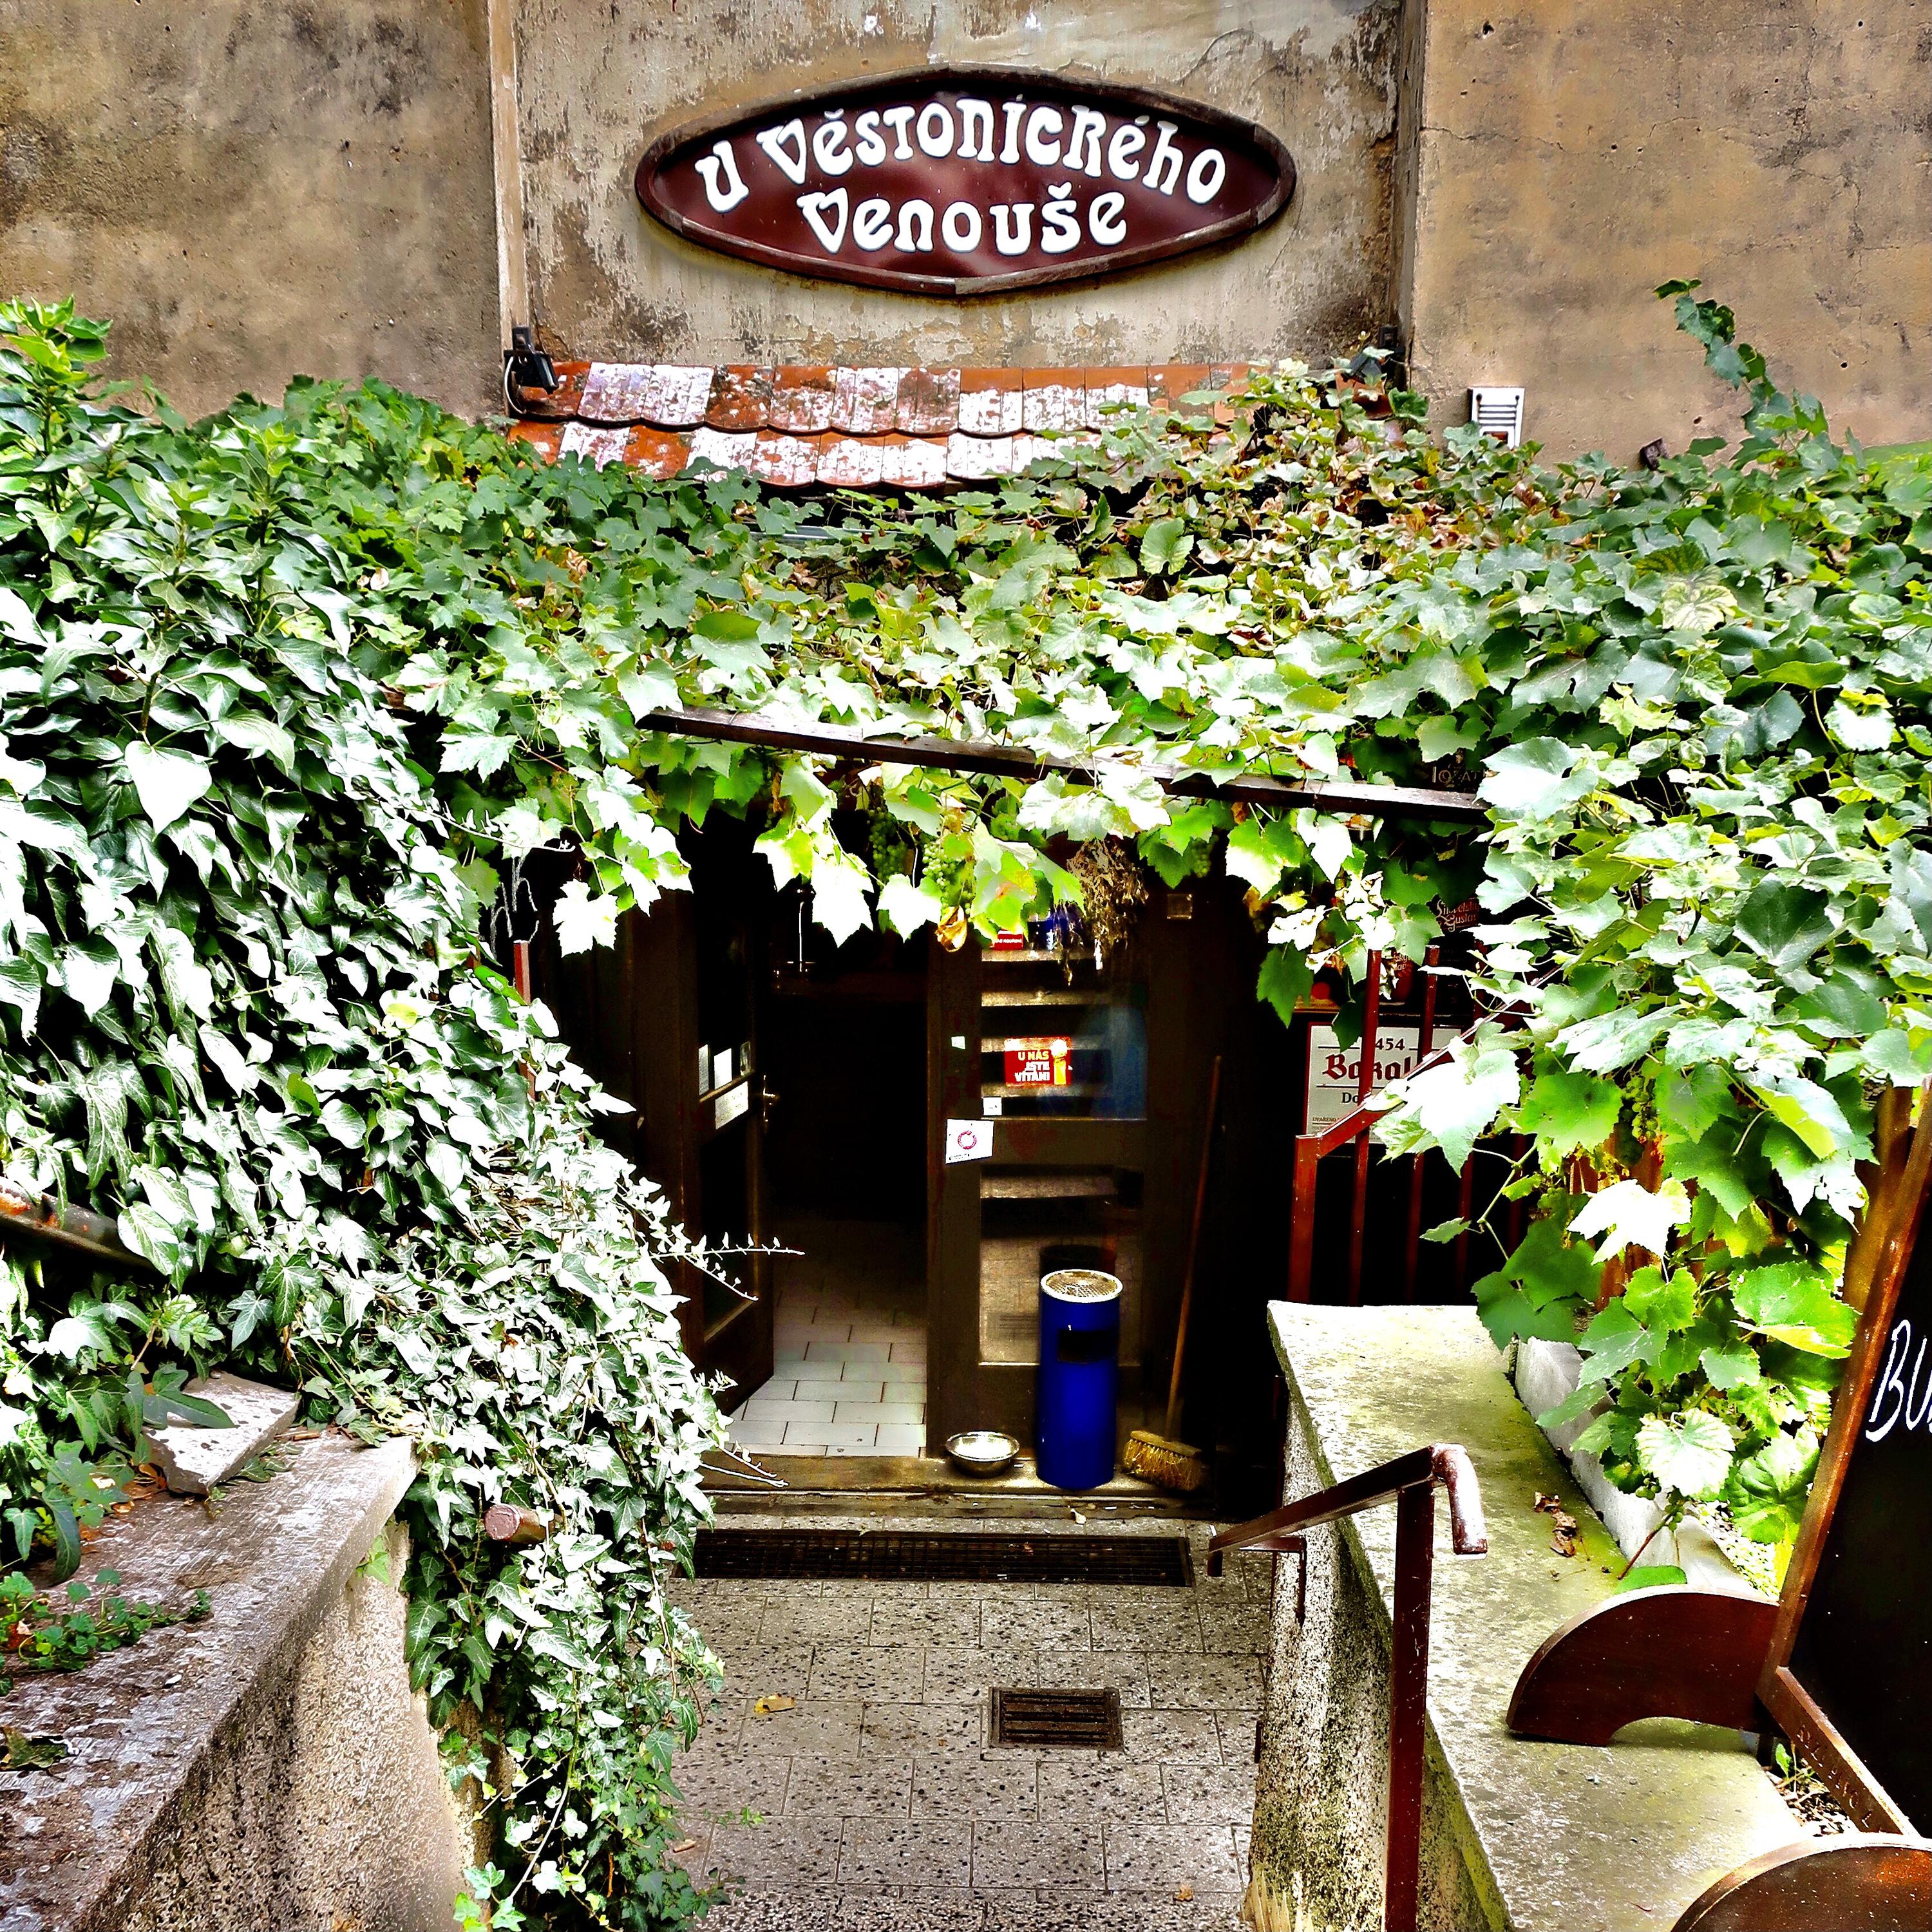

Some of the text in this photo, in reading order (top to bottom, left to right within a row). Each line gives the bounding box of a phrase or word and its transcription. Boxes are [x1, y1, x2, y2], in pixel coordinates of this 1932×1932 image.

[694, 140, 750, 213] U
[796, 182, 1127, 254] Venouše
[1018, 1051, 1026, 1061] U
[1376, 1037, 1405, 1050] 454
[1865, 1319, 1932, 1443] BU
